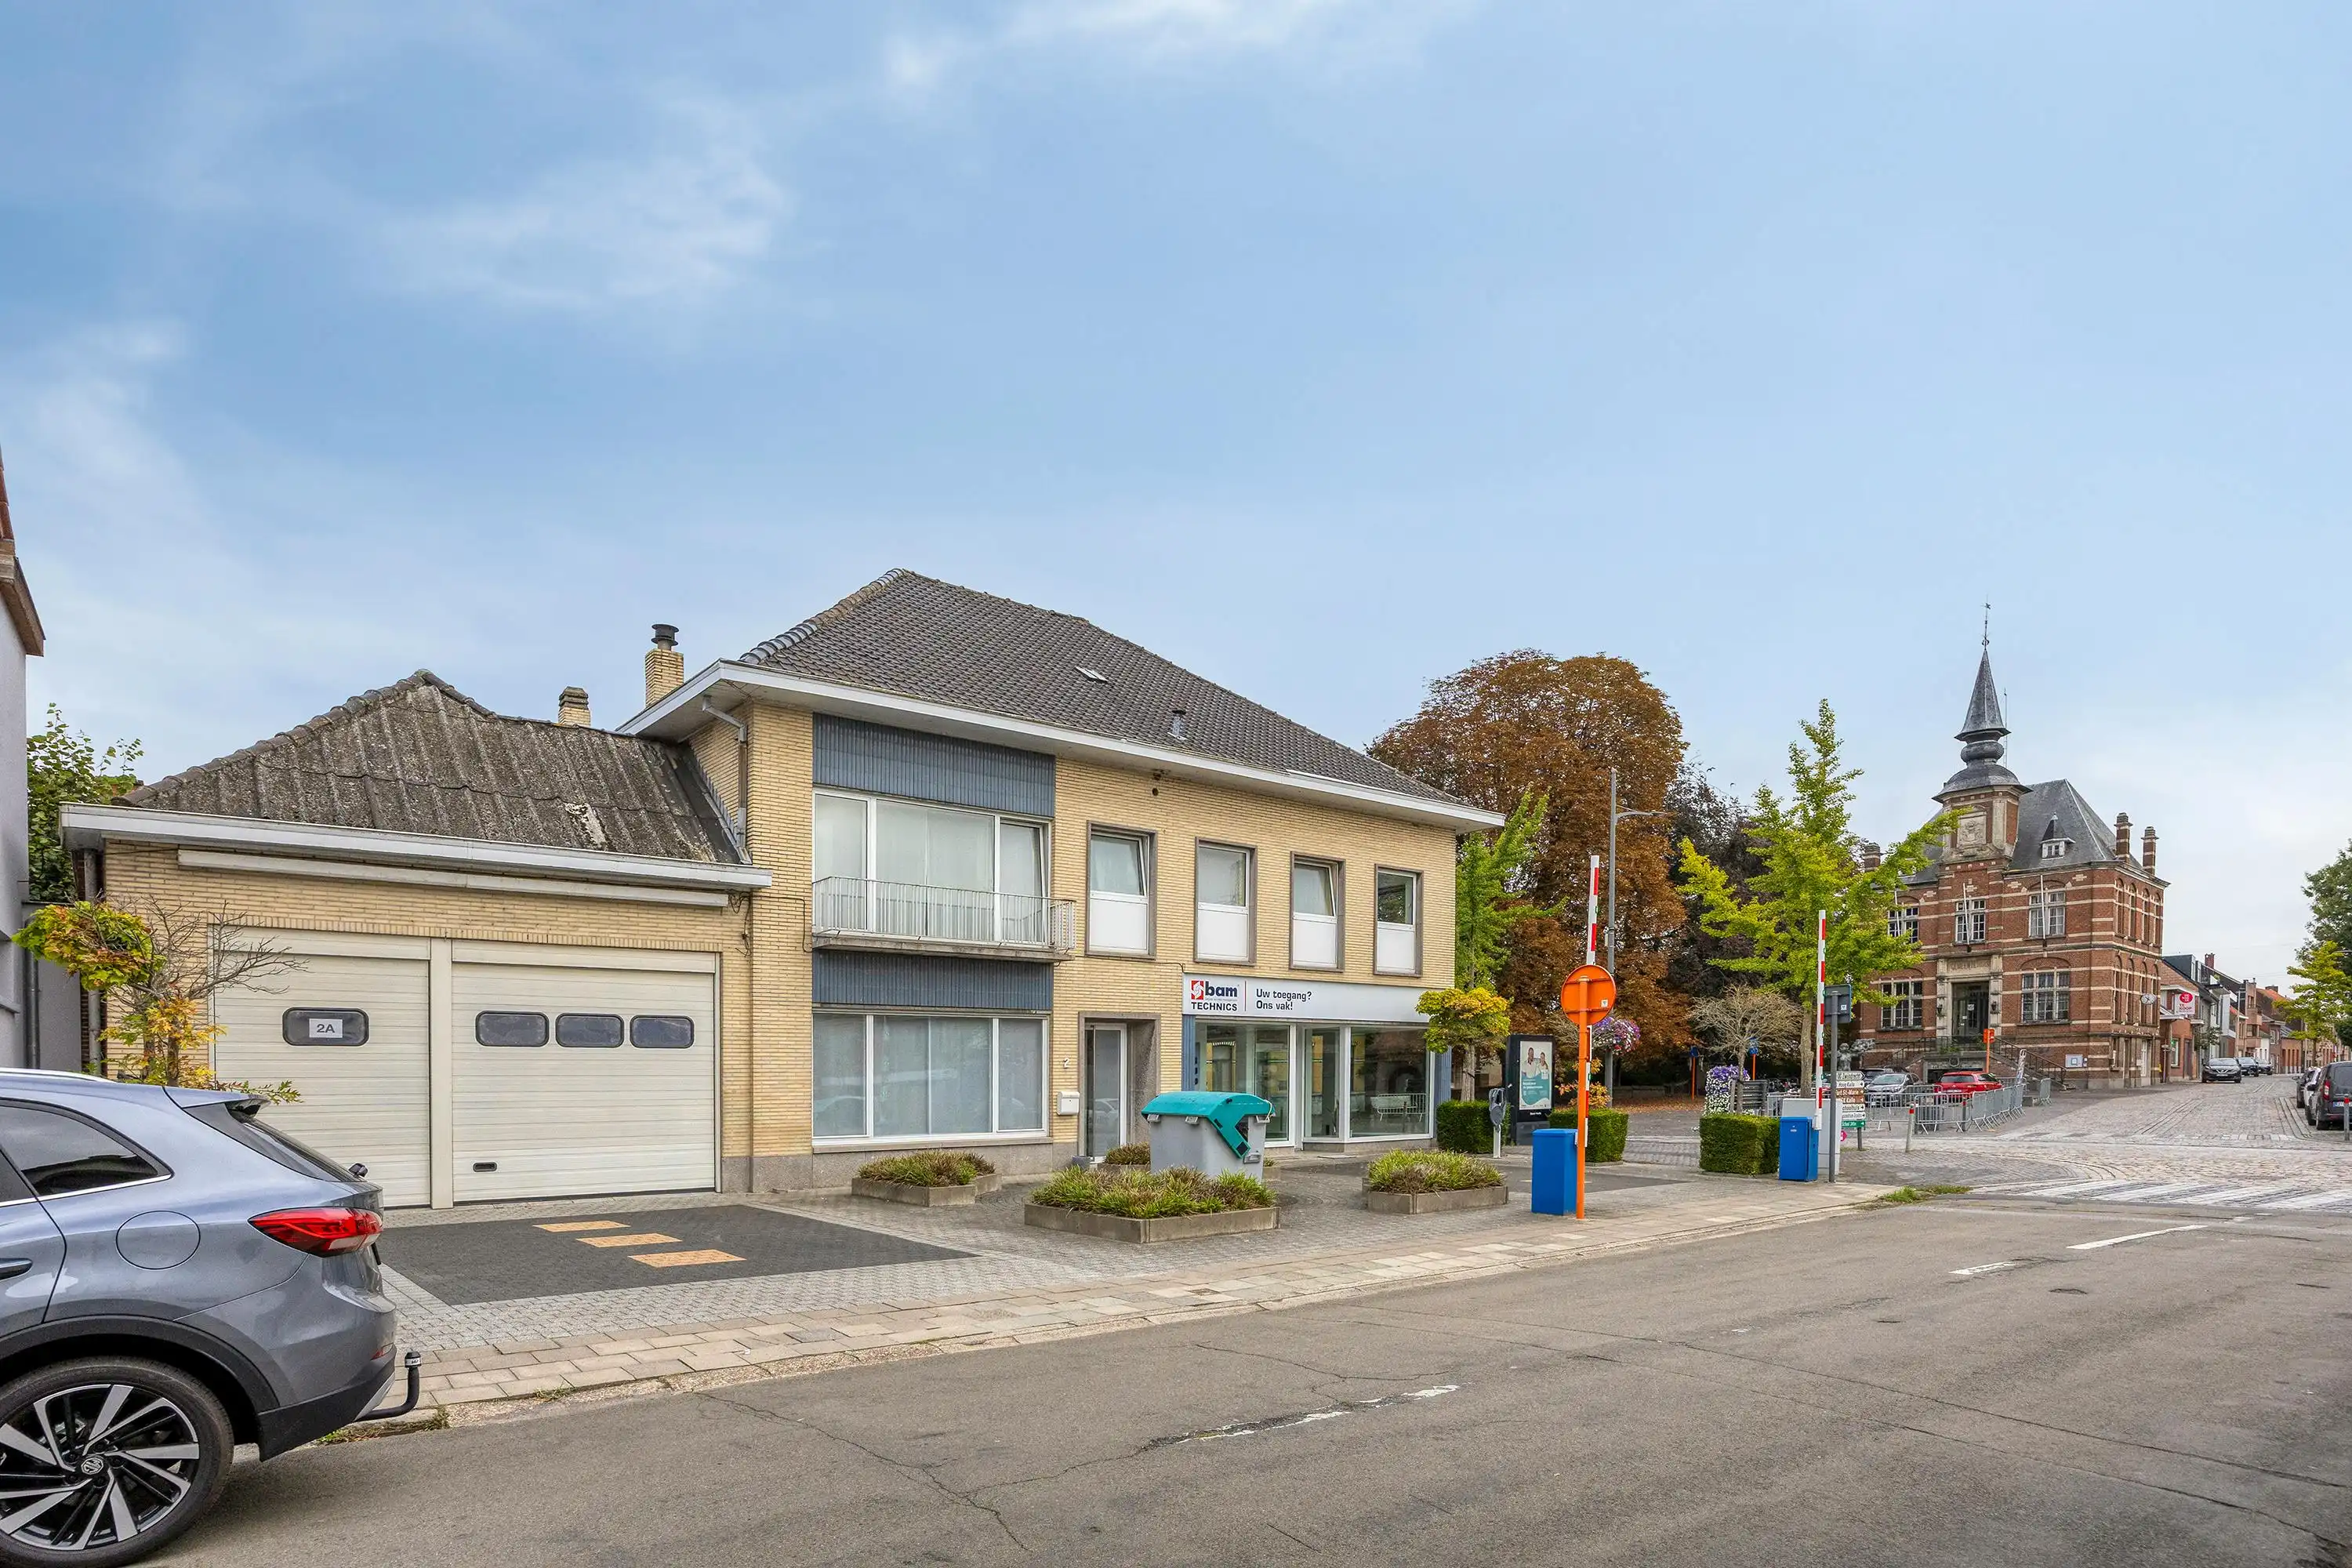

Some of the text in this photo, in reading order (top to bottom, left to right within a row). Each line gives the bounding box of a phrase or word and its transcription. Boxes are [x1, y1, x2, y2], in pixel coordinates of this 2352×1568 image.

[1205, 981, 1238, 997] bam
[1256, 988, 1312, 1002] Uw toegang?
[1191, 1002, 1237, 1011] TECHNICS
[1256, 1000, 1293, 1011] Ons vak!
[316, 1023, 336, 1033] 2A
[1063, 1058, 1070, 1068] 2
